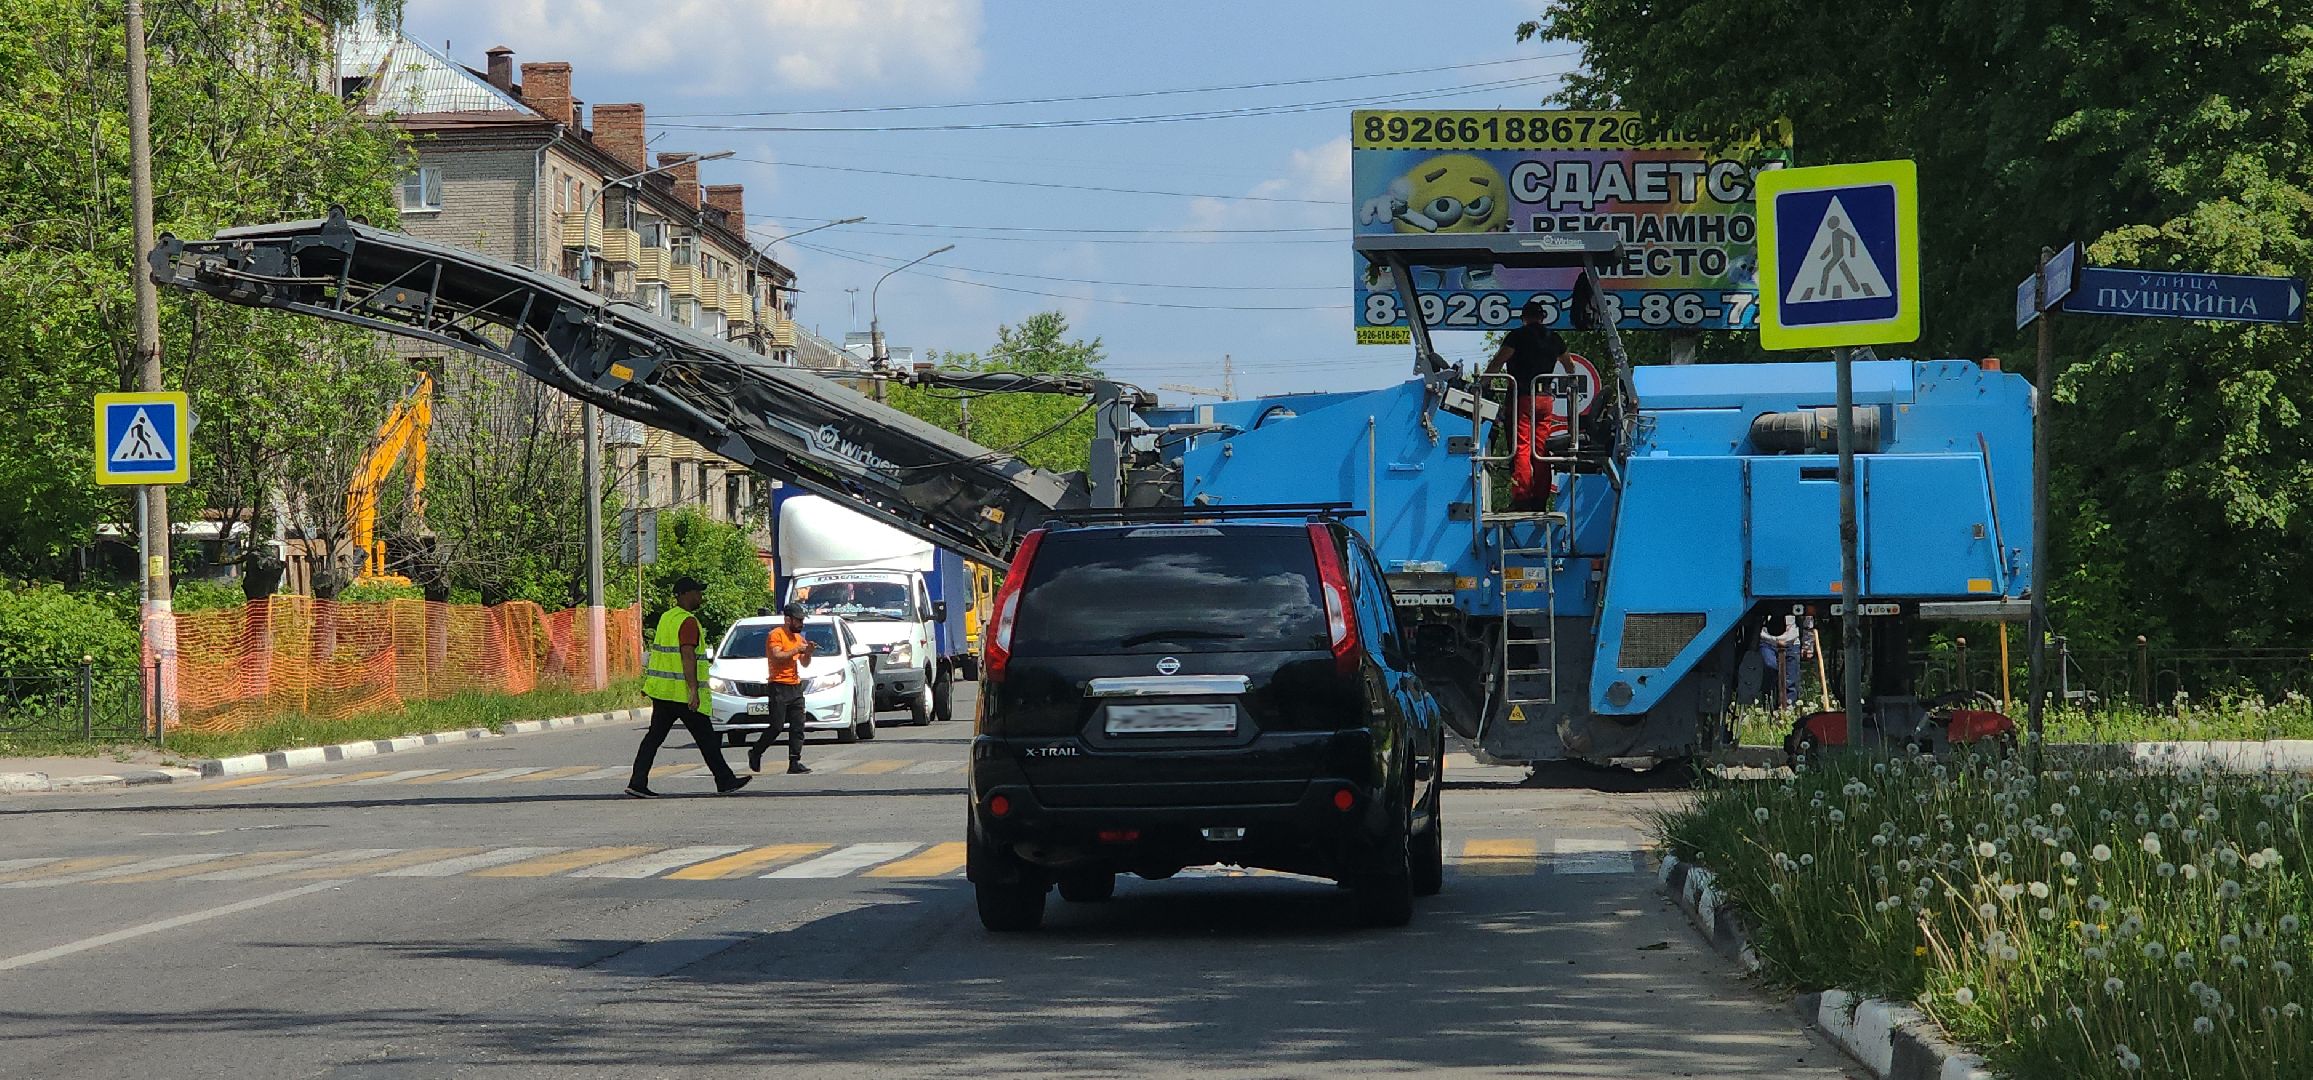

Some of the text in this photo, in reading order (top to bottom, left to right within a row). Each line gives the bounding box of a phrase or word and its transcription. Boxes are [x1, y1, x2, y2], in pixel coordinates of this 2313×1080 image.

[2139, 275, 2219, 290] УЛИЦА
[1365, 292, 1760, 328] 8-926-68-86-7
[2097, 288, 2258, 316] ПУШКИНА
[1025, 747, 1081, 757] X-TRAIL
